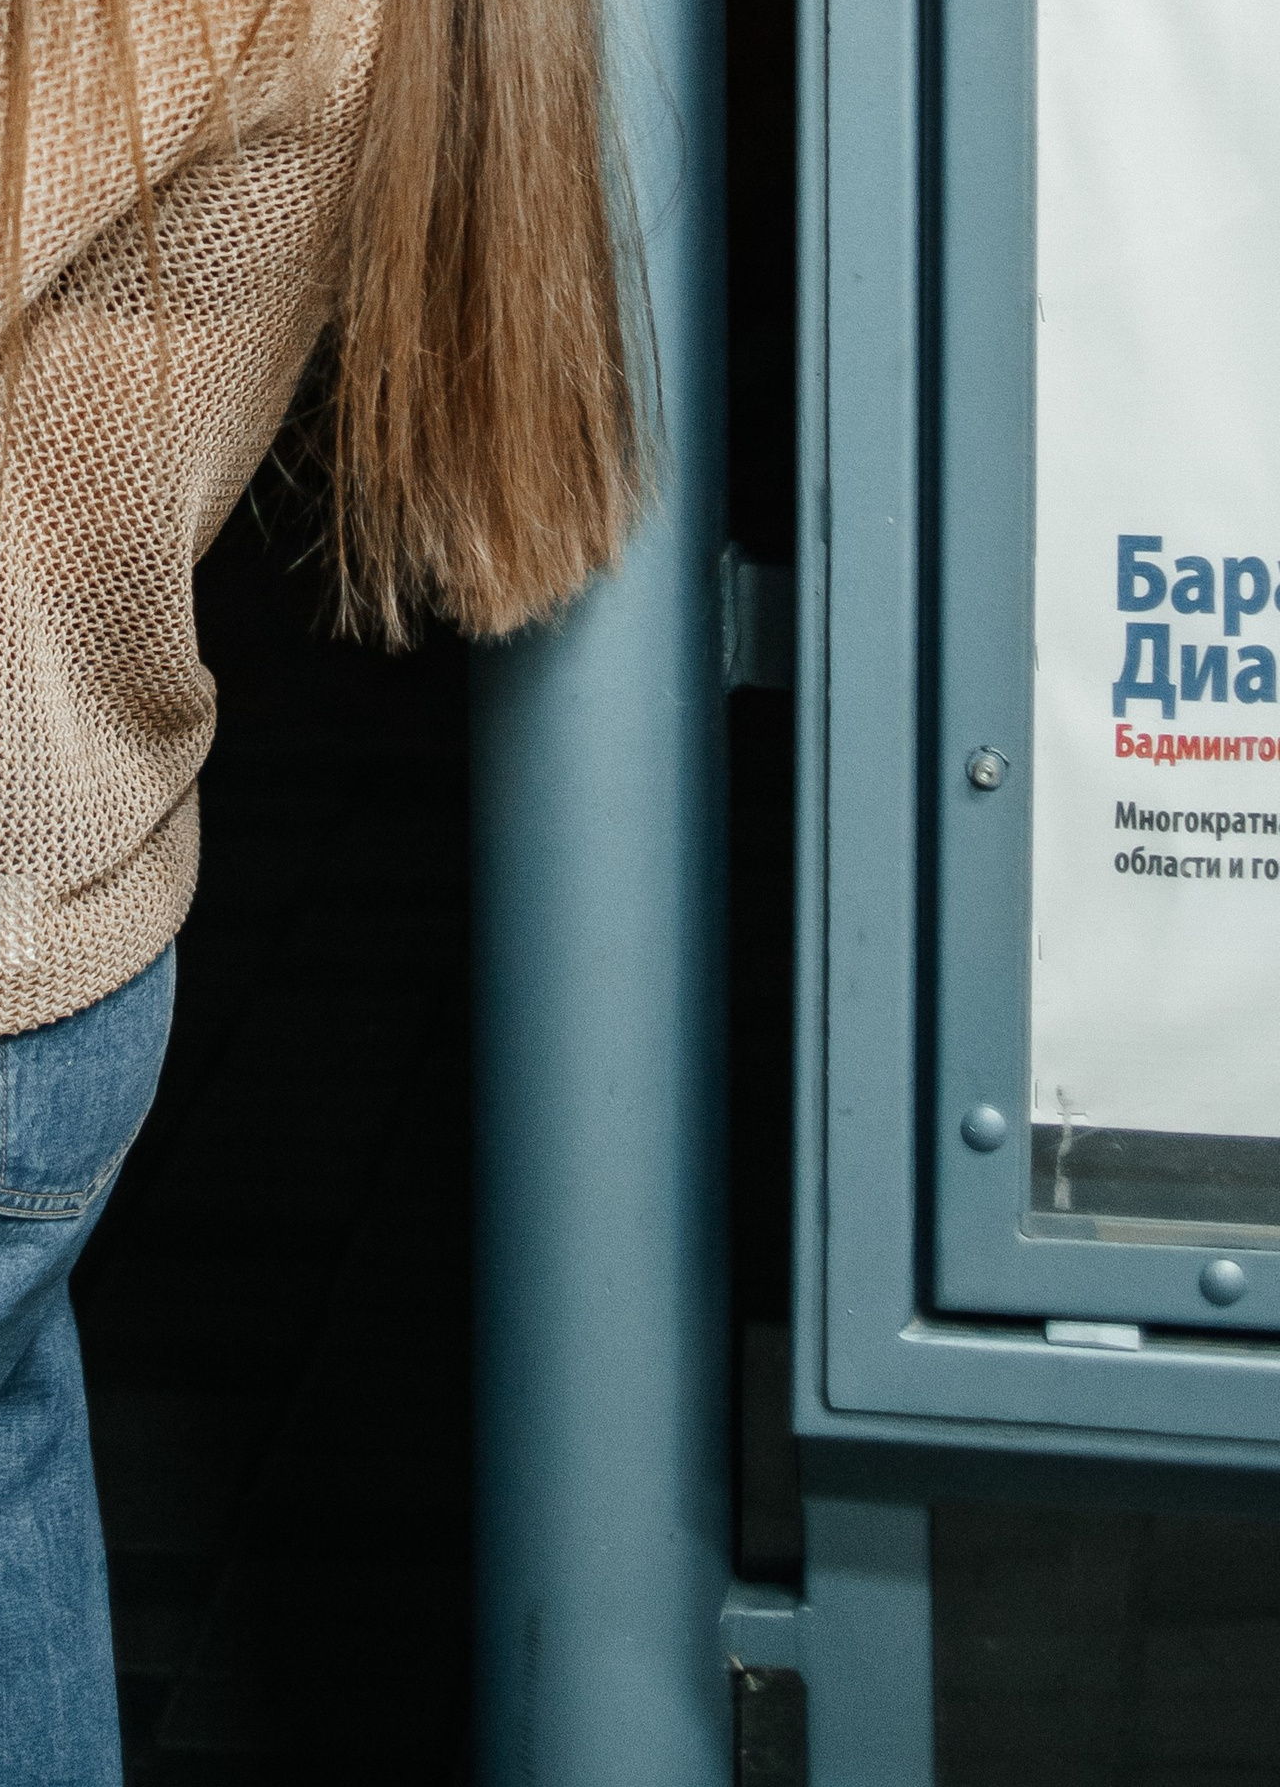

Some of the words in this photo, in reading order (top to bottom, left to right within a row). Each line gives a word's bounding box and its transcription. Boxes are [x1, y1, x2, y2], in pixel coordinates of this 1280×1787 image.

[1116, 534, 1280, 637] Бар
[1112, 622, 1278, 720] Диа
[1115, 723, 1280, 766] Бадминто
[1114, 801, 1280, 841] Многократн
[1114, 845, 1221, 879] области
[1228, 857, 1244, 880] и
[1251, 857, 1280, 881] го
